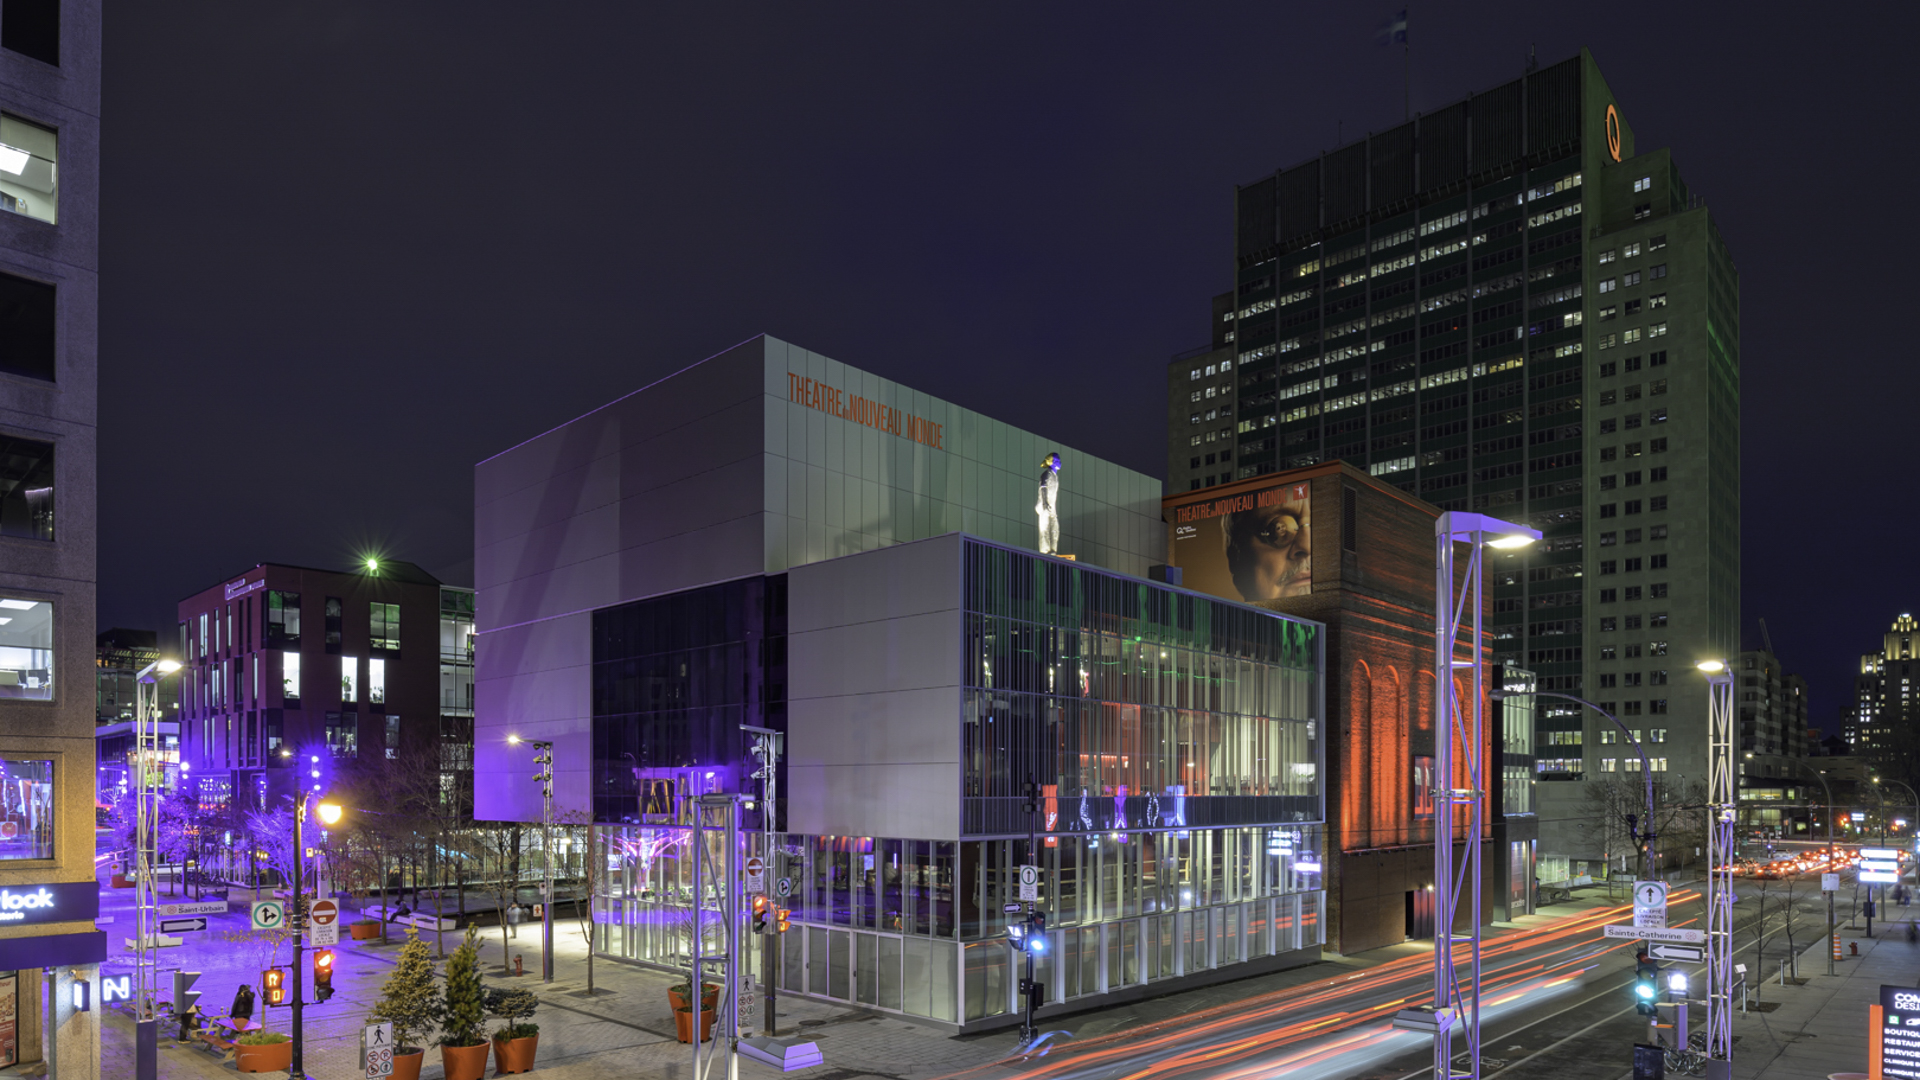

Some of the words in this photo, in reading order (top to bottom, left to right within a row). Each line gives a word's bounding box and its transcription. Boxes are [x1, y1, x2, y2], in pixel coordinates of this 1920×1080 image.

[1605, 104, 1622, 163] Q
[850, 394, 902, 437] NOUVEAU
[907, 413, 944, 450] MONDE
[1215, 494, 1254, 516] NOUVEAU
[1257, 487, 1288, 508] MONDE
[178, 906, 225, 914] Saint-Urbain
[1607, 928, 1682, 940] Sainte-Catherine
